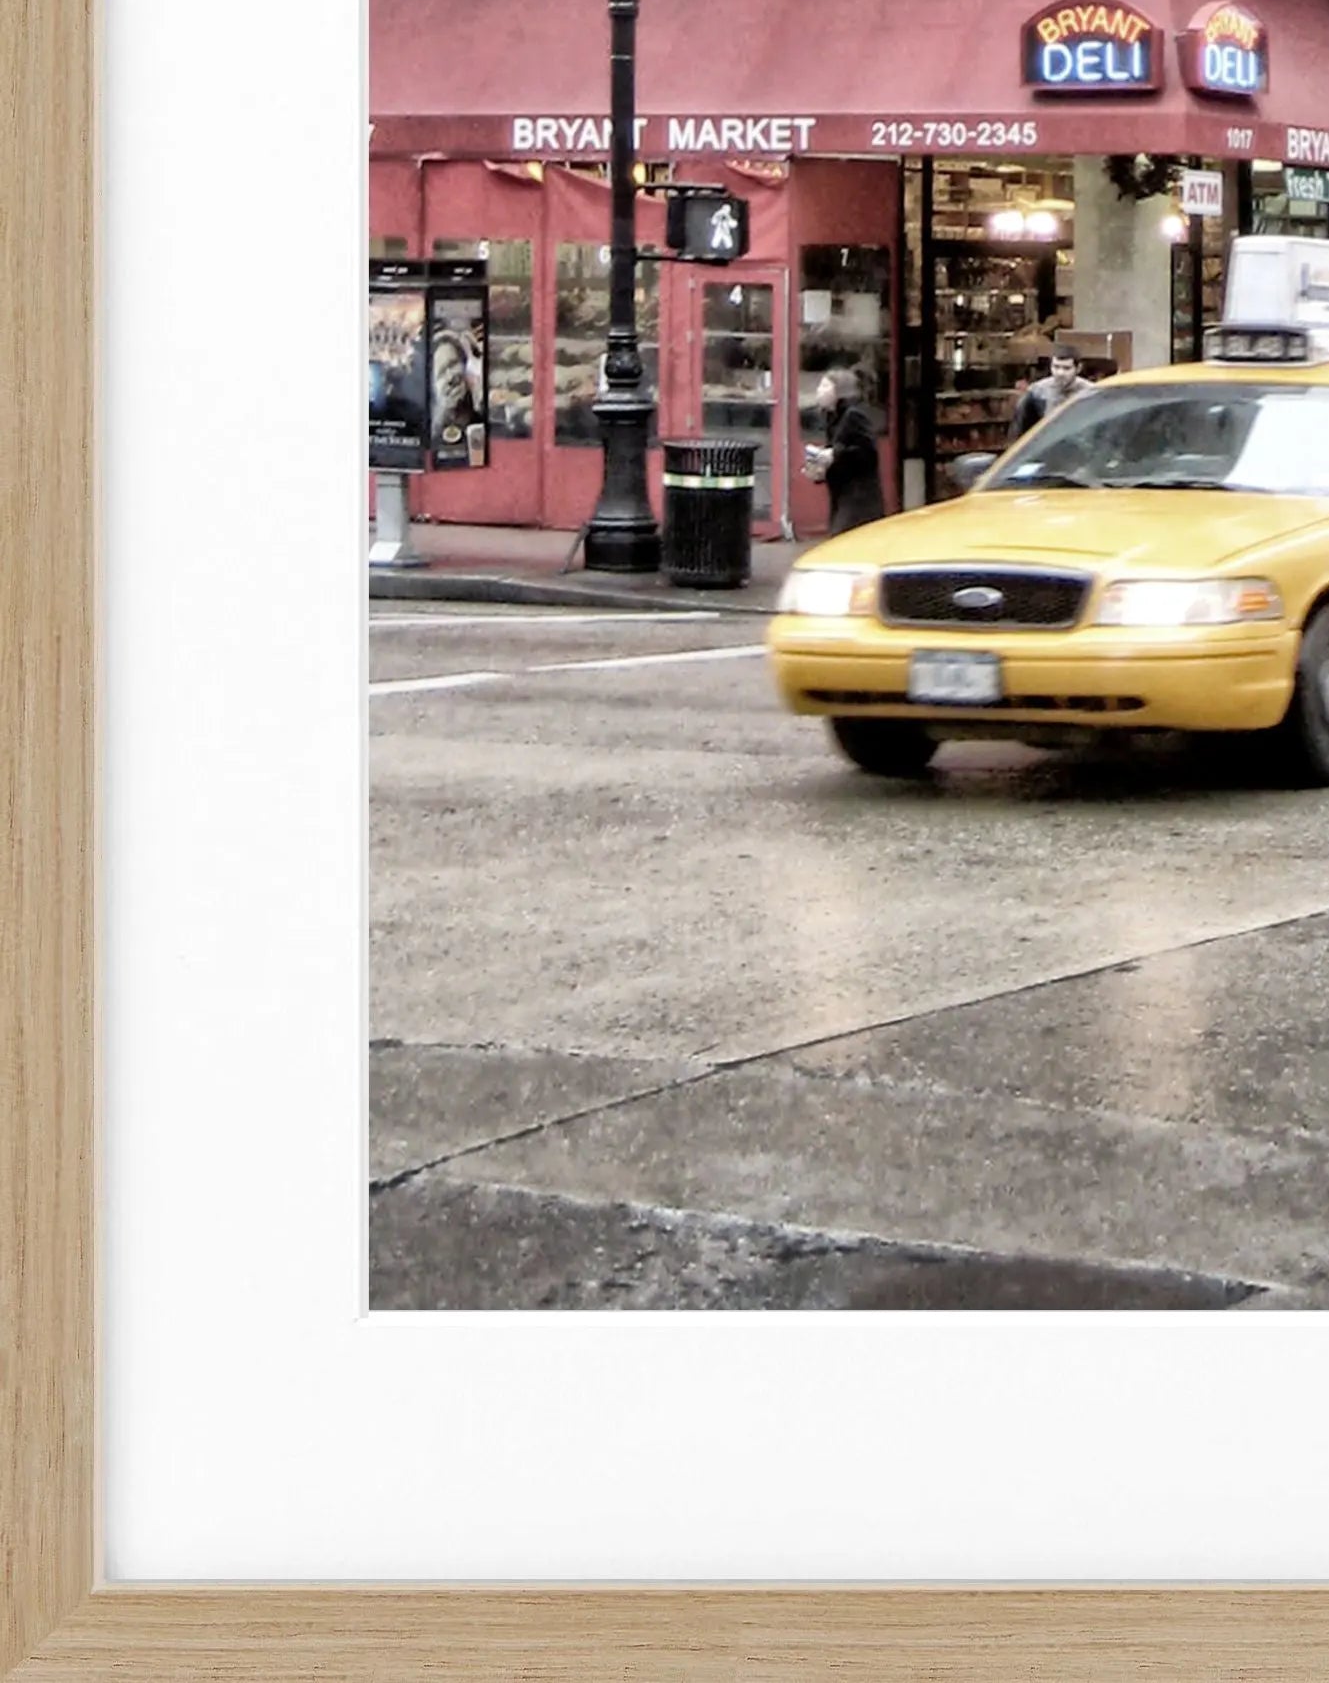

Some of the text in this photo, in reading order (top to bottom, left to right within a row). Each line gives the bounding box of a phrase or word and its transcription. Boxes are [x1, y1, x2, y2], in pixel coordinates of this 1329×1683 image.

[1036, 5, 1151, 44] BRYANT
[1204, 7, 1259, 51] BRYANT
[1042, 40, 1143, 82] DELI
[1203, 43, 1256, 88] DELI
[668, 117, 817, 151] MARKET
[870, 121, 1039, 148] 212-730-2345
[1226, 128, 1254, 151] 1017
[1187, 181, 1220, 206] ATM
[1286, 169, 1325, 200] Fresh
[478, 240, 490, 261] 5
[839, 247, 849, 267] 7
